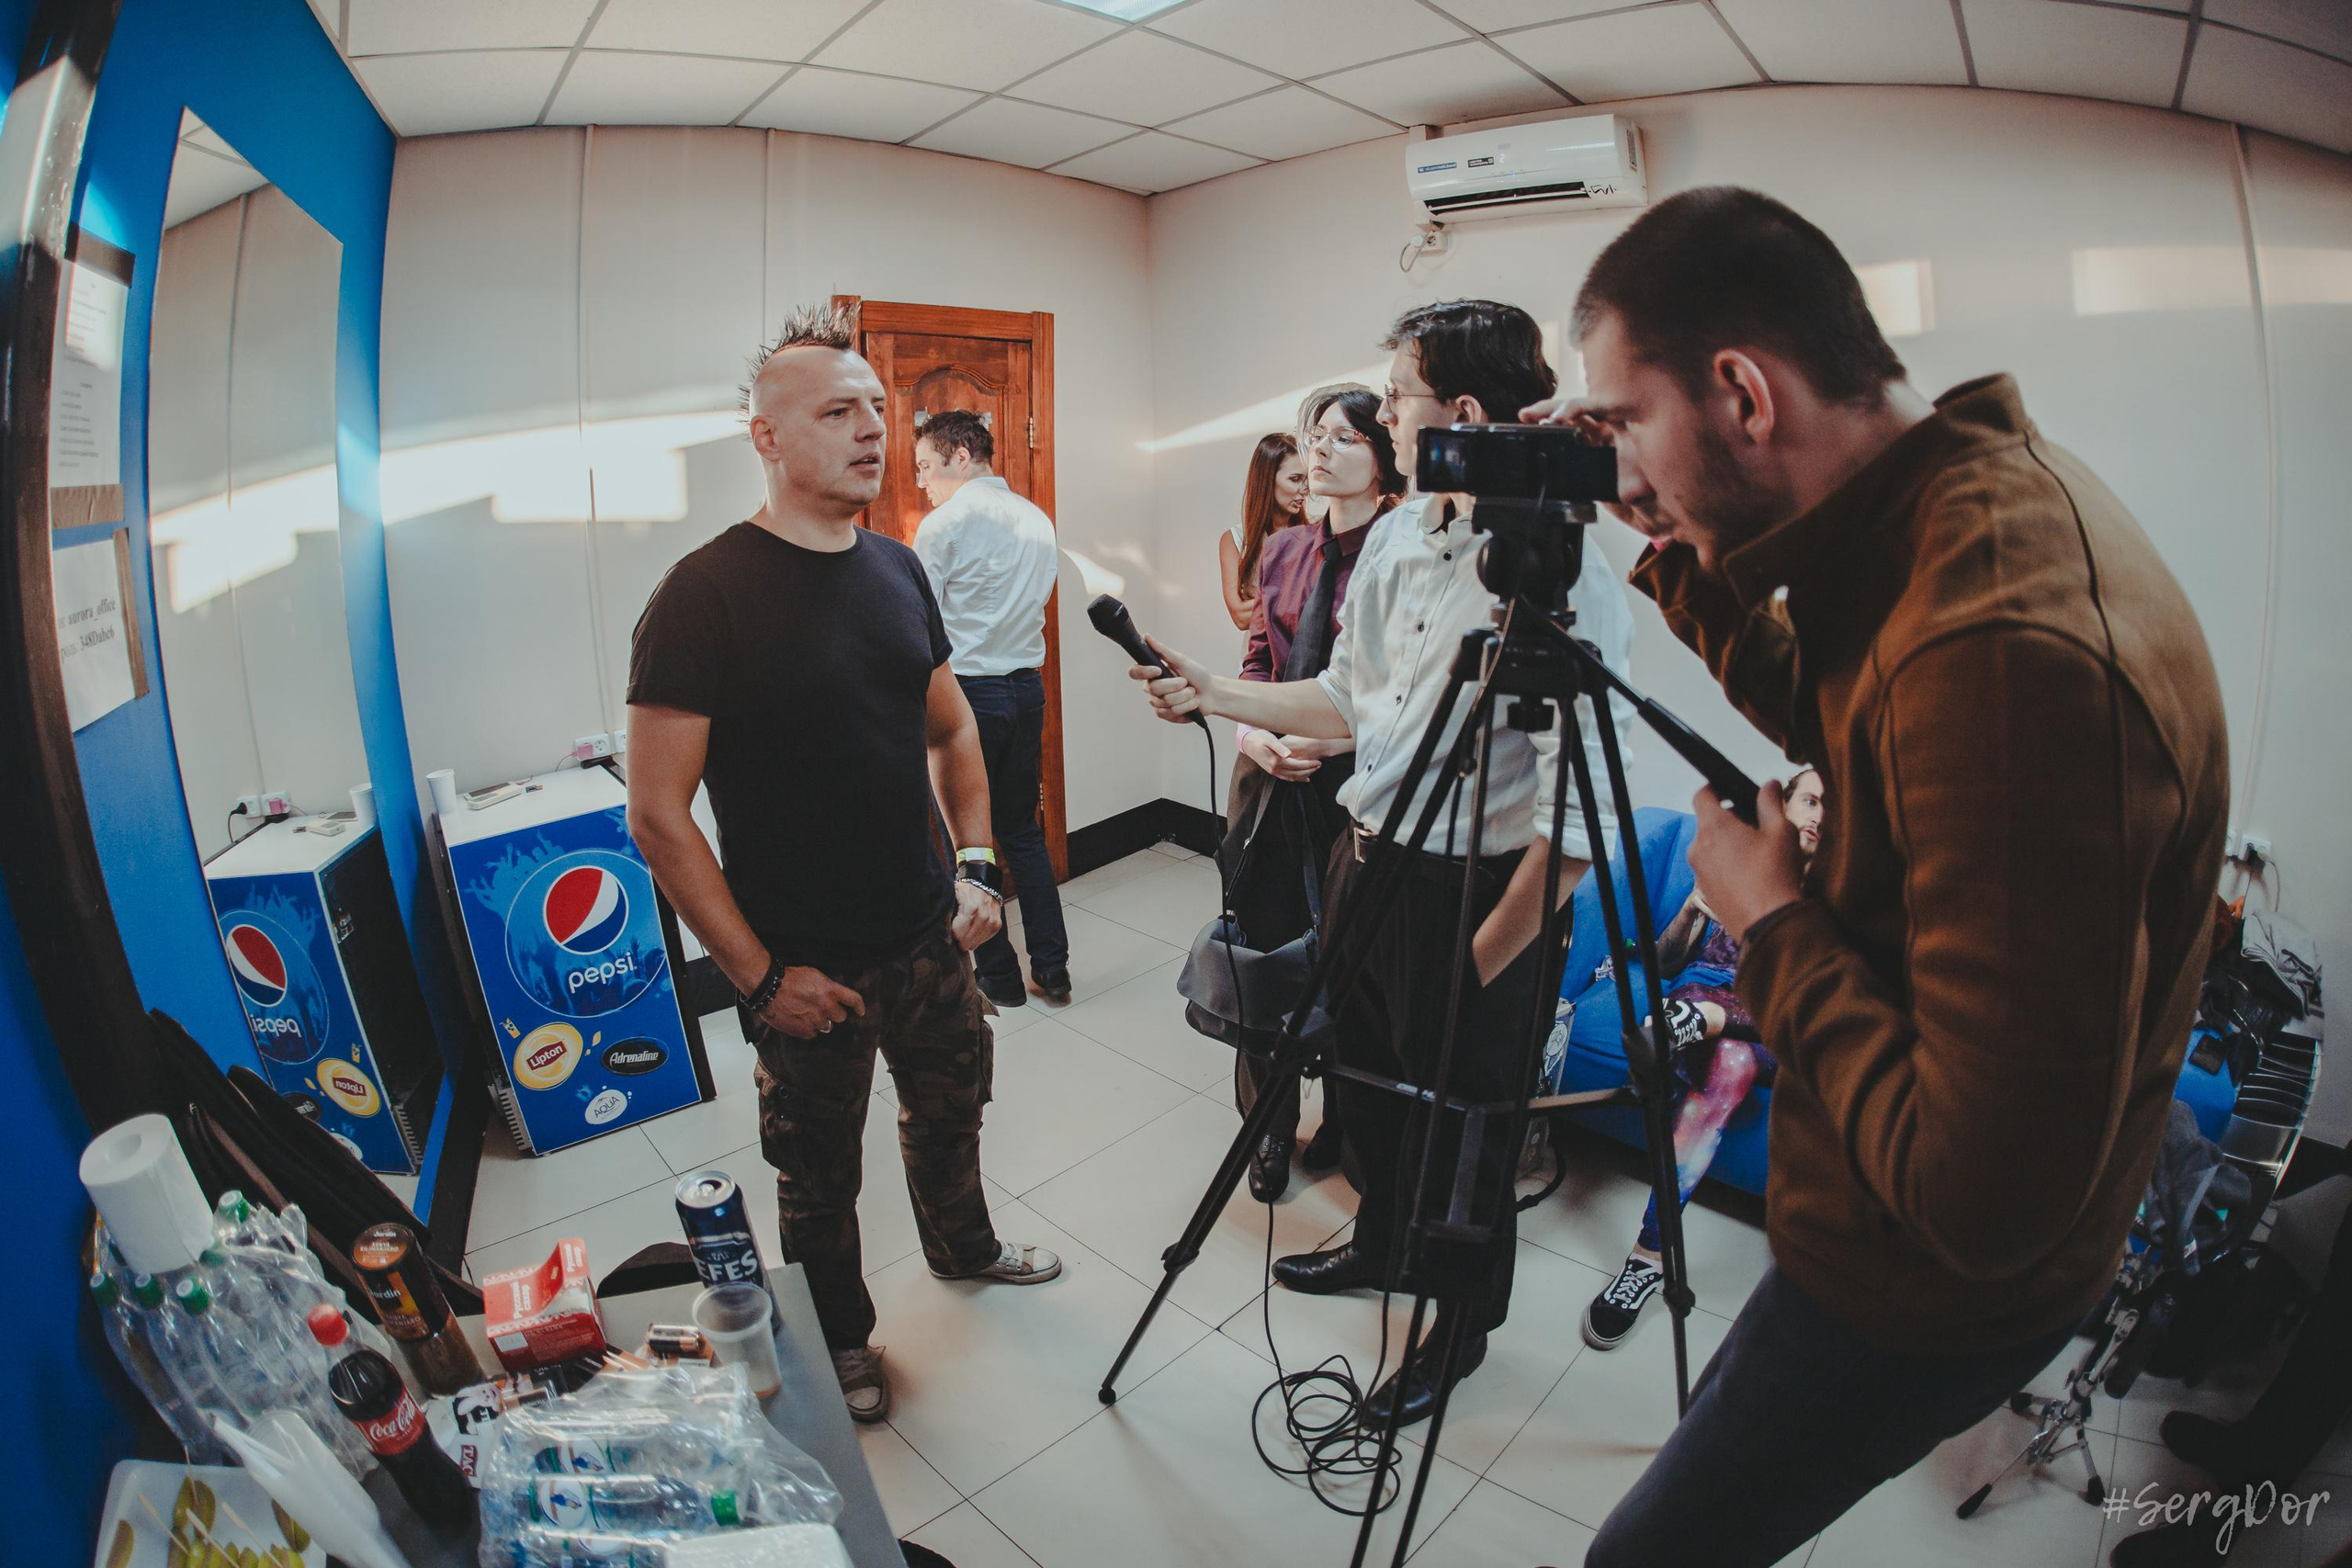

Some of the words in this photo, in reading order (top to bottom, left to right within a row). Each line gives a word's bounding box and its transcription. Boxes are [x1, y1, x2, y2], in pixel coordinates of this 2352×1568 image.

[568, 951, 636, 994] pepsi
[529, 1044, 564, 1068] Lipton
[609, 1050, 659, 1067] Adrenaline
[594, 1096, 621, 1120] AQUA
[693, 1249, 758, 1281] EFES
[511, 1280, 525, 1319] Русский
